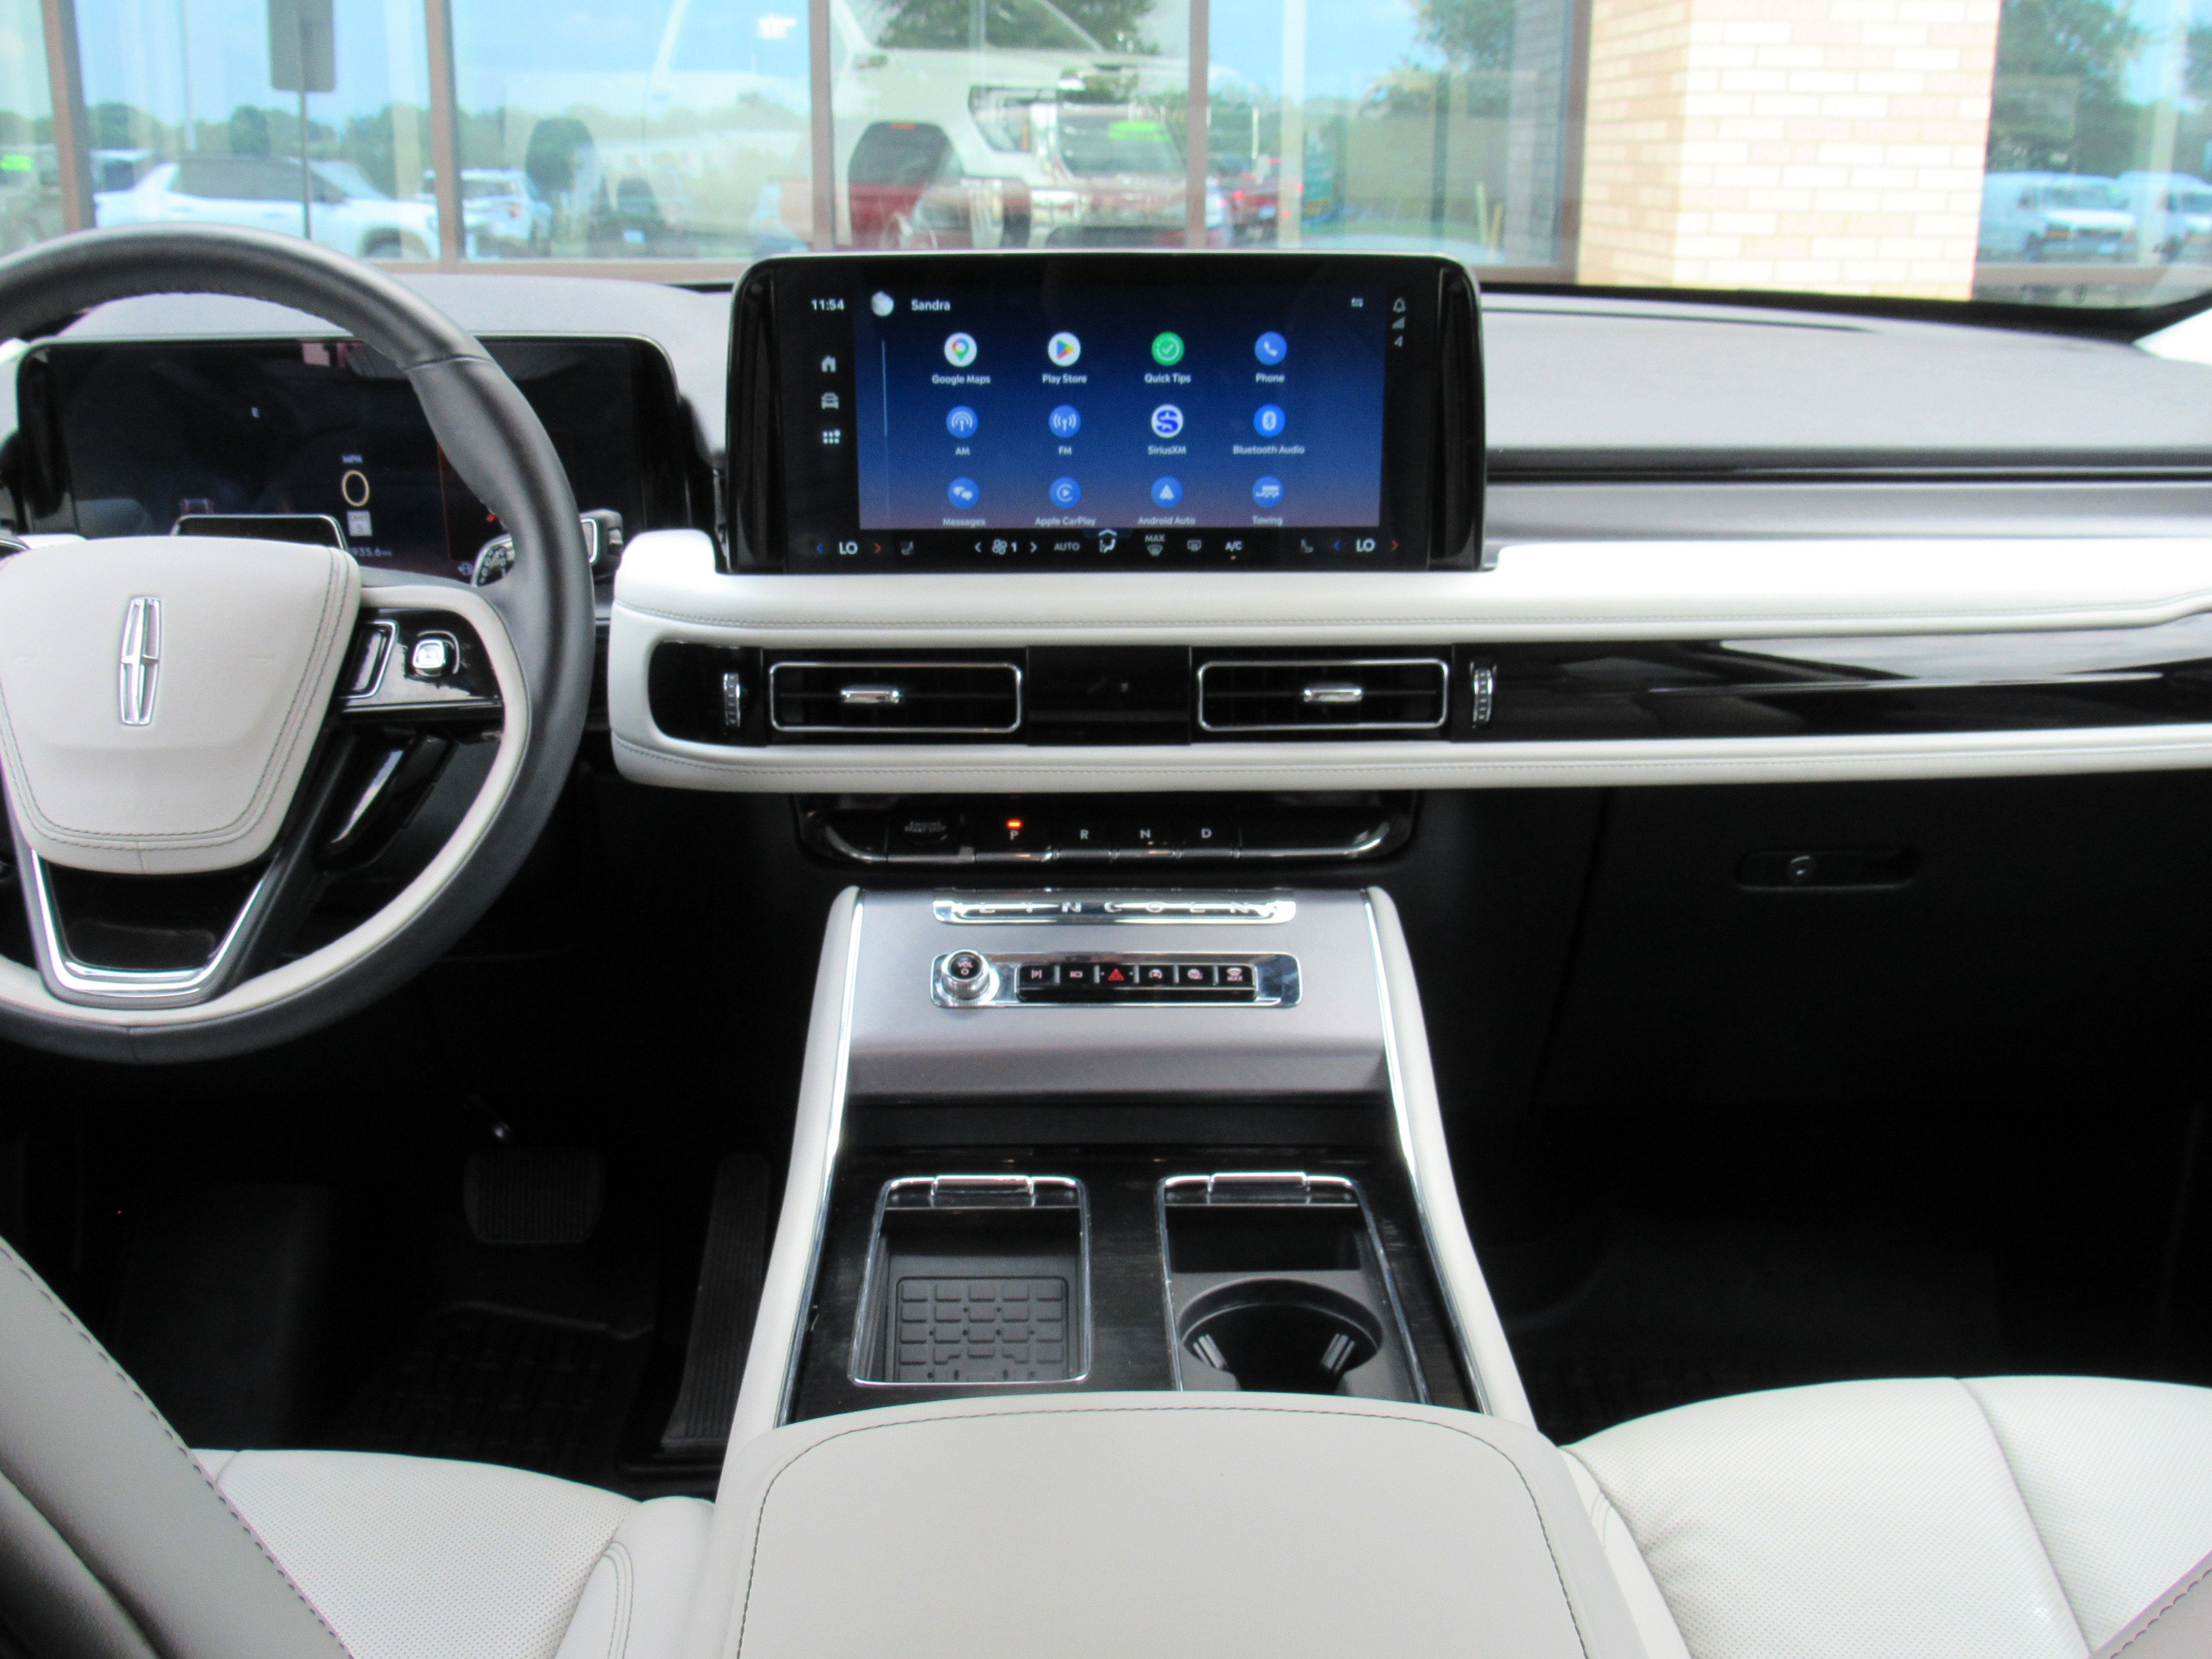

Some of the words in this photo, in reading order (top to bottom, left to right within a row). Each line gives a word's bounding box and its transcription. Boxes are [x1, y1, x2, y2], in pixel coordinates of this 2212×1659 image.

[811, 300, 845, 311] 11:54
[910, 299, 951, 312] Sandra
[931, 374, 964, 385] Google
[966, 374, 991, 385] Maps
[1042, 373, 1060, 385] Play
[1062, 374, 1087, 384] Store
[1144, 373, 1170, 384] Quick
[1172, 373, 1191, 384] Tips
[1255, 373, 1284, 383] Phone
[955, 446, 970, 456] AM
[1058, 446, 1072, 455] FM
[1147, 445, 1186, 455] SiriusXM
[1232, 445, 1277, 455] Bluetooth
[1279, 445, 1305, 455] Audio
[942, 517, 986, 527] Messages
[1035, 517, 1061, 527] Apple
[1062, 517, 1096, 527] CarPlay
[1138, 516, 1173, 526] Android
[1175, 516, 1196, 526] Auto
[1252, 516, 1283, 526] Towing
[839, 542, 858, 554] LO
[1054, 542, 1081, 551] AUTO
[1224, 541, 1243, 552] A/C
[1355, 539, 1375, 552] LO
[1009, 830, 1019, 840] P
[1080, 829, 1089, 840] R
[1140, 829, 1151, 840] N
[1202, 828, 1212, 839] D
